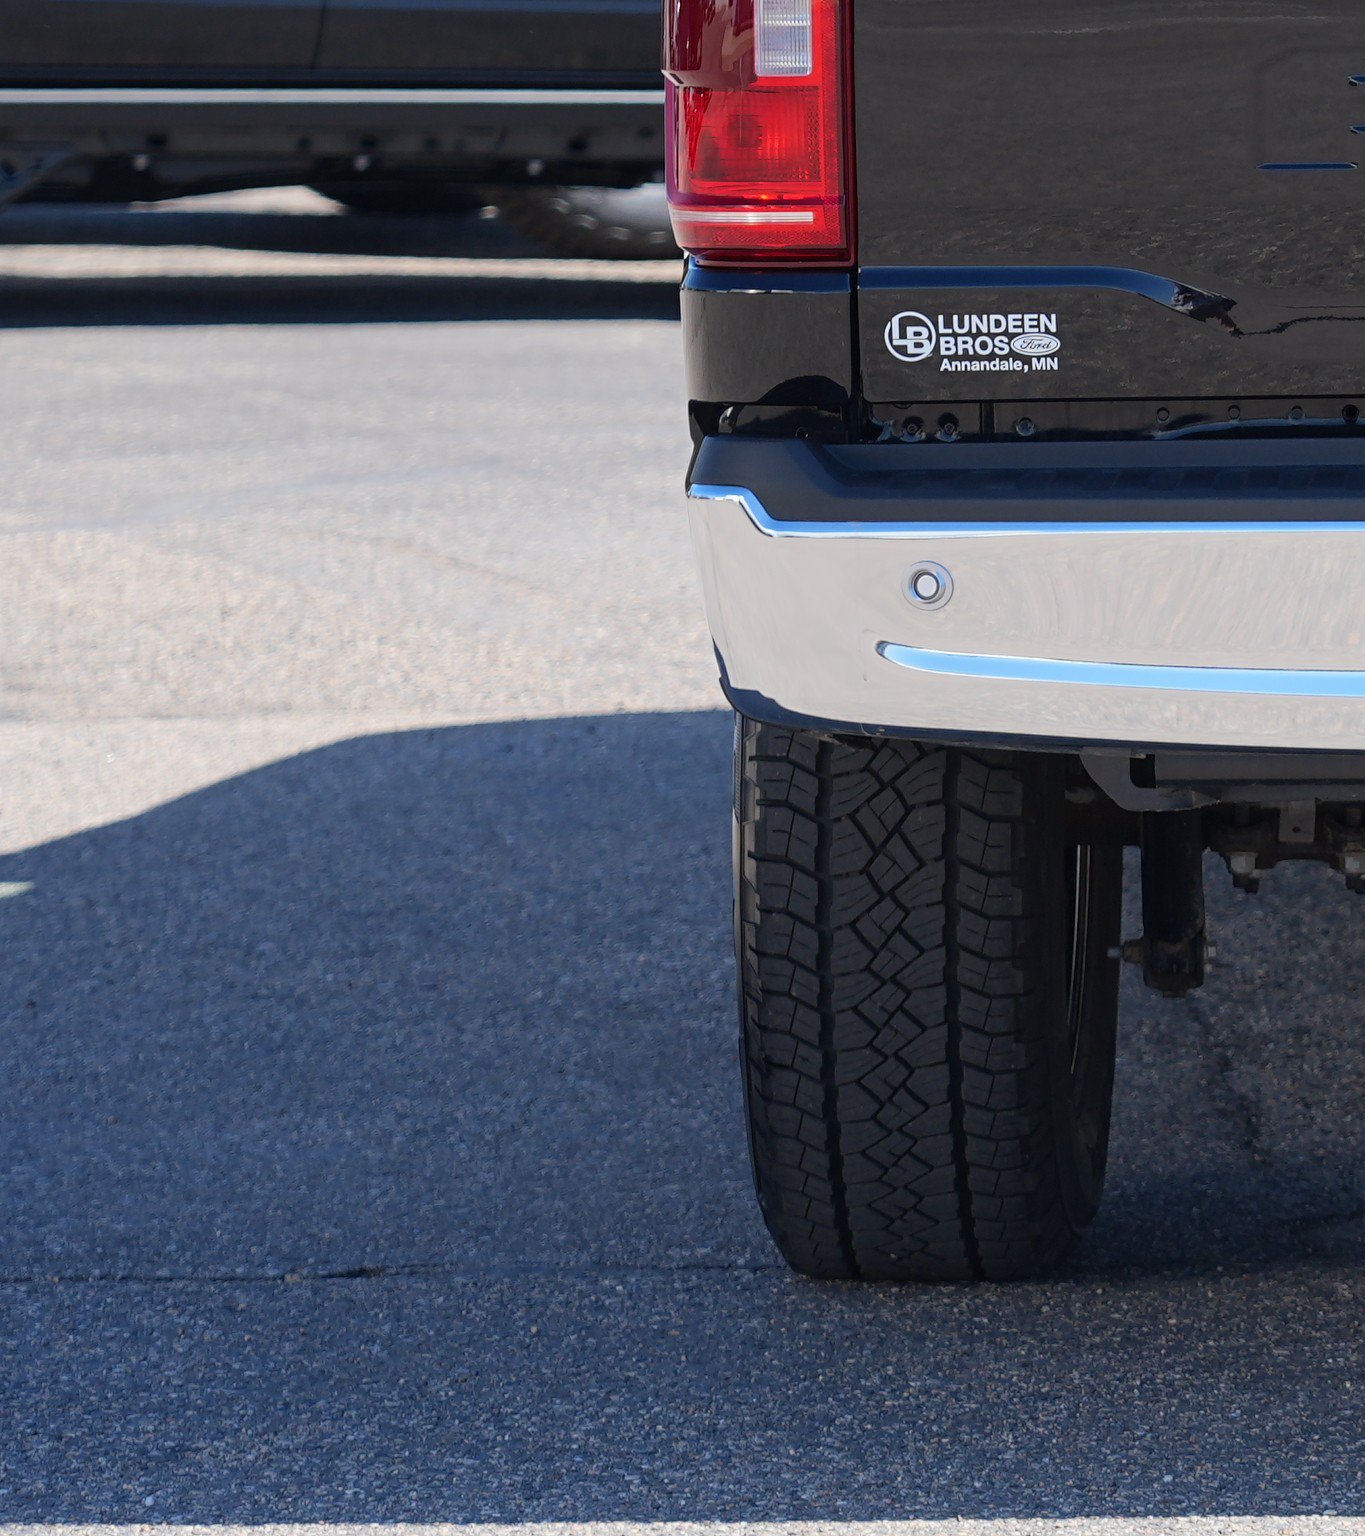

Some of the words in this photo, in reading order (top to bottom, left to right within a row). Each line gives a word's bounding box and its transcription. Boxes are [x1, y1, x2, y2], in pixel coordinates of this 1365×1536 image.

[938, 313, 1057, 334] LUNDEEN
[939, 336, 1011, 356] BROS
[939, 357, 1029, 373] Annandale,
[1032, 356, 1058, 371] MN
